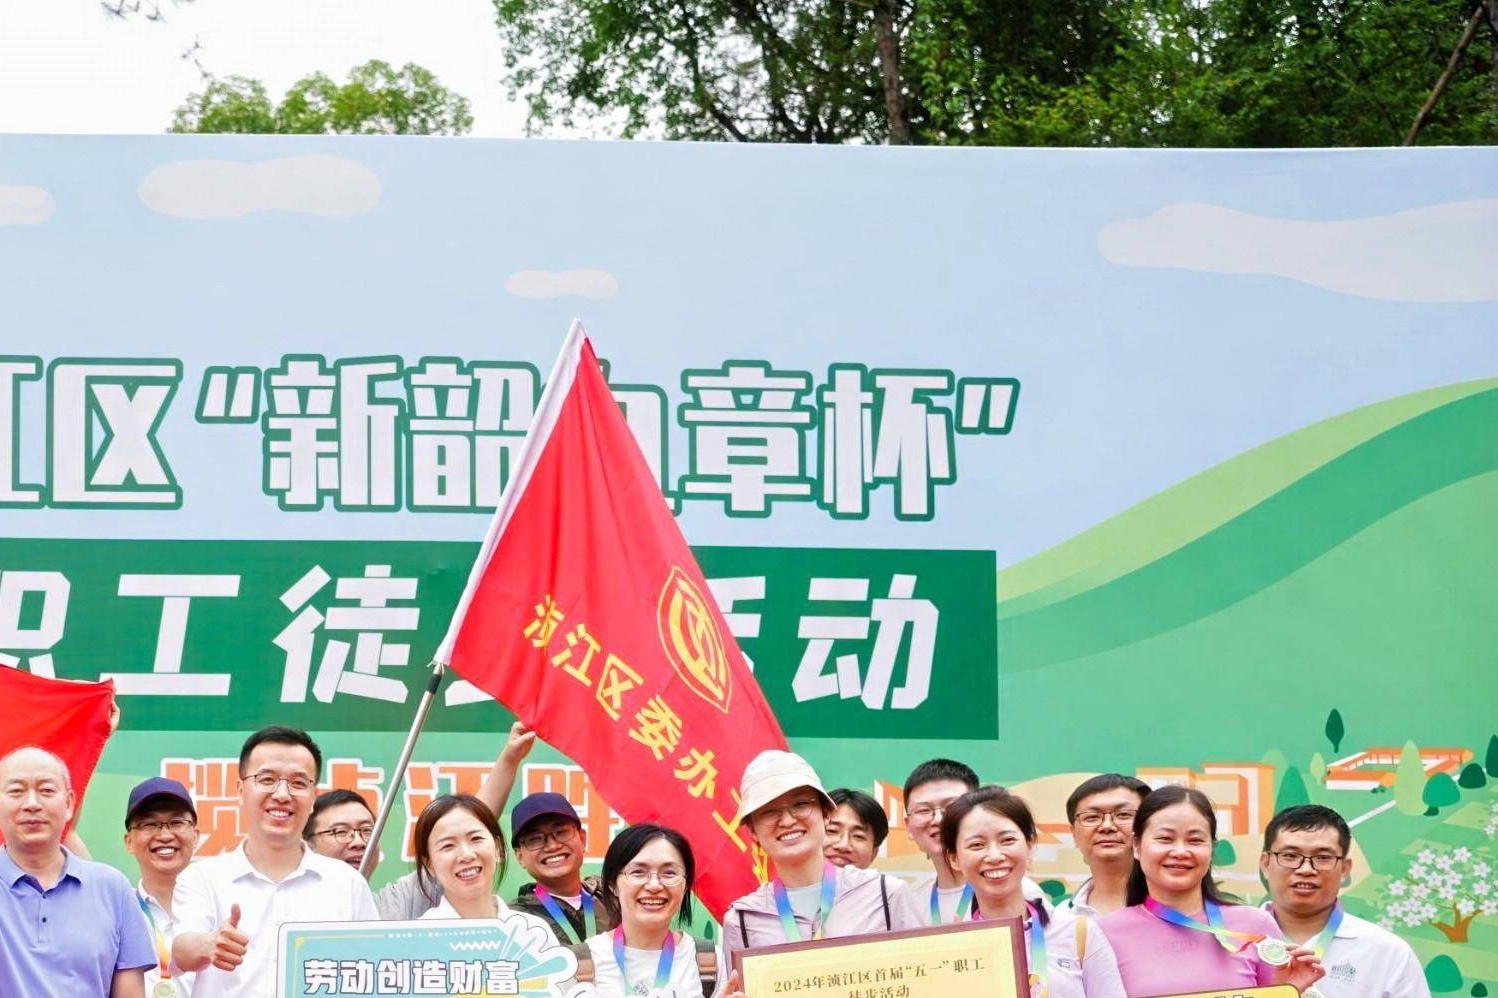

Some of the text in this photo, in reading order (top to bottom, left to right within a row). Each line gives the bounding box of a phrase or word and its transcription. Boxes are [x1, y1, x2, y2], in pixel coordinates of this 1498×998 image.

[304, 960, 520, 996] 劳动创造财富
